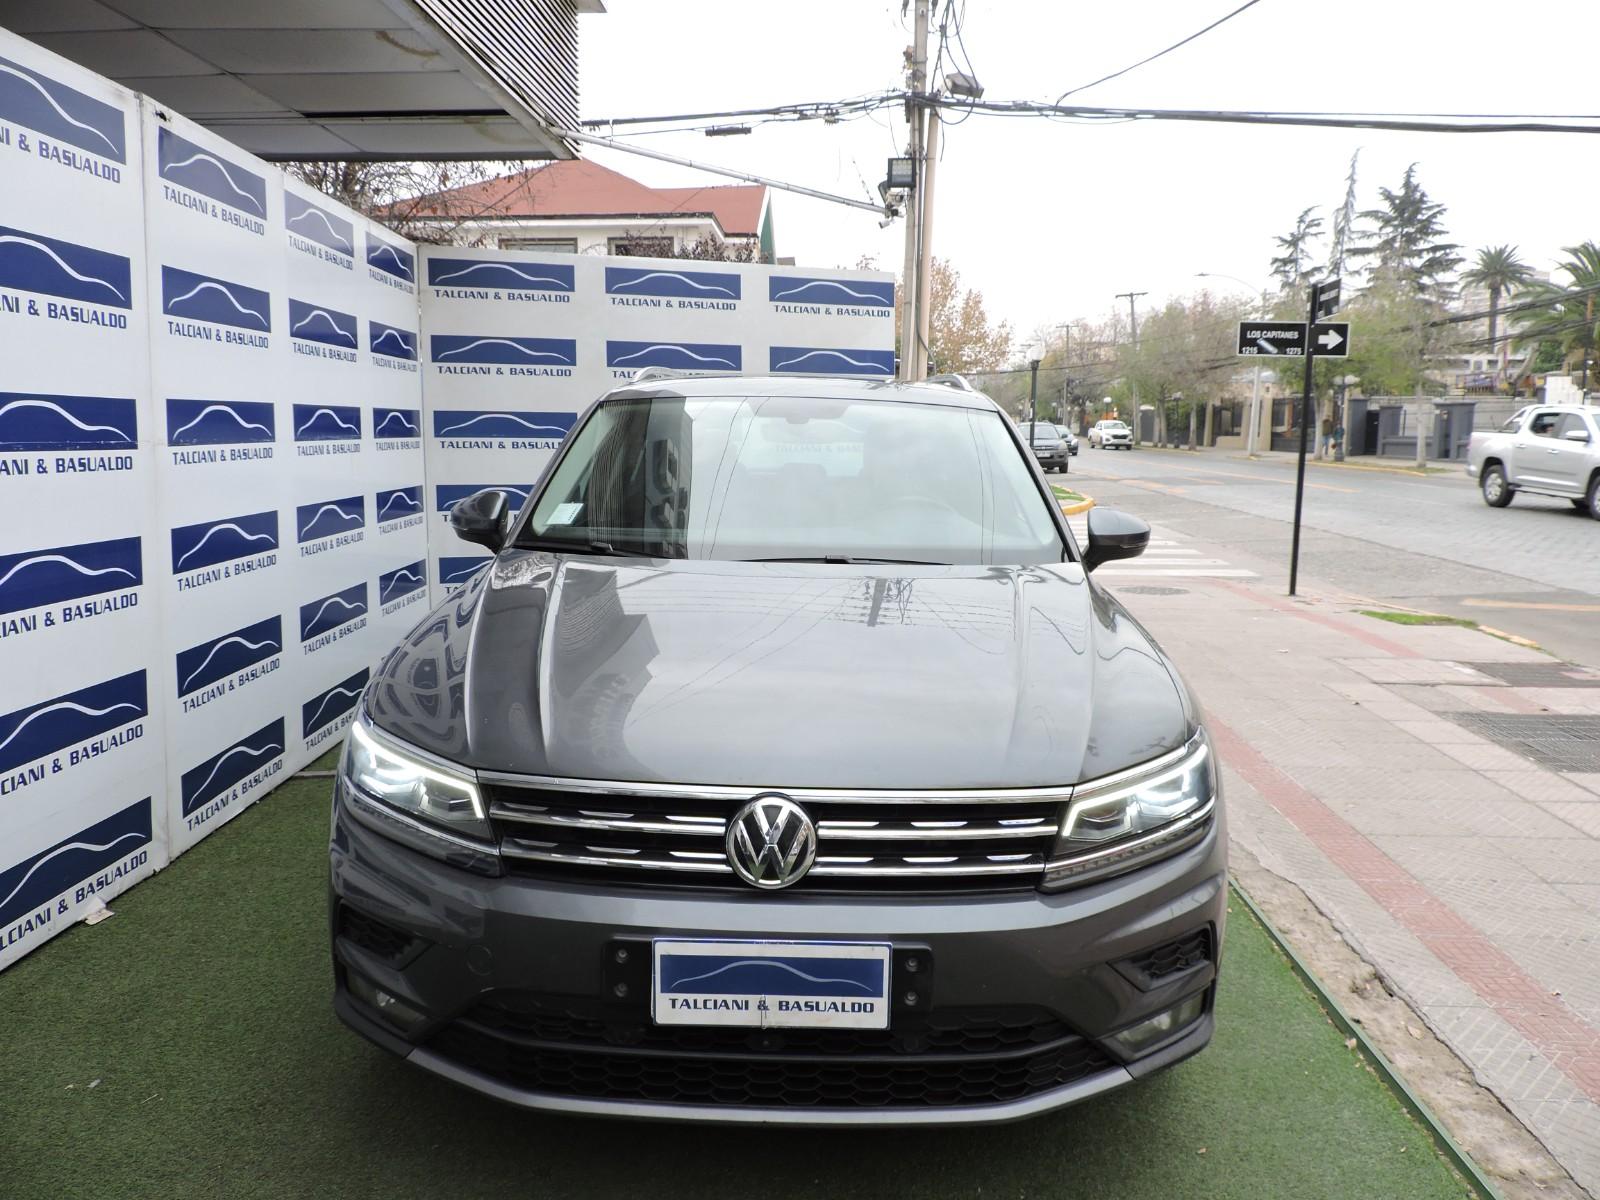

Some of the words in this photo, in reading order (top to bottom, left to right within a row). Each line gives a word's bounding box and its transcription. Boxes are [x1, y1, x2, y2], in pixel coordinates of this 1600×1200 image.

[19, 134, 31, 152] &
[39, 141, 120, 184] BASUALDO
[163, 185, 208, 218] TALCIANI
[211, 207, 218, 218] &
[221, 209, 264, 236] BASUALDO
[434, 289, 488, 299] TALCIANI
[494, 291, 501, 300] &
[508, 293, 570, 303] BASUALDO
[611, 297, 661, 307] TALCIANI
[665, 300, 673, 308] &
[679, 301, 736, 311] BASUALDO
[28, 300, 40, 316] &
[48, 303, 127, 329] BASUALDO
[774, 305, 821, 315] TALCIANI
[825, 307, 832, 316] &
[837, 308, 890, 317] BASUALDO
[168, 321, 212, 340] TALCIANI
[216, 330, 222, 342] &
[225, 331, 269, 349] BASUALDO
[1262, 331, 1299, 339] CAPITANES
[438, 366, 491, 375] TALCIANI
[496, 367, 504, 375] &
[510, 367, 572, 377] BASUALDO
[173, 450, 217, 465] TALCIANI
[220, 449, 226, 461] &
[230, 447, 273, 461] BASUALDO
[440, 440, 493, 449] TALCIANI
[498, 441, 505, 449] &
[512, 441, 561, 449] BASUAL
[37, 459, 48, 474] &
[56, 456, 133, 473] BASUALDO
[177, 568, 221, 592] TALCIANI
[224, 566, 231, 578] &
[234, 554, 277, 576] BASUALDO
[0, 614, 36, 638] IANI
[44, 612, 55, 627] &
[63, 592, 138, 623] BASUALDO
[183, 683, 225, 713] TALCIANI
[228, 680, 235, 692] &
[238, 658, 280, 687] BASUALDO
[1, 764, 44, 795] CIANI
[52, 758, 63, 774] &
[70, 724, 143, 767] BASUALDO
[187, 795, 229, 832] TALCIANI
[232, 789, 238, 801] &
[241, 759, 282, 796] BASUALDO
[0, 908, 51, 951] LCIANI
[58, 899, 68, 915] &
[75, 850, 148, 904] BASUALDO
[669, 998, 749, 1011] TALCIANI
[757, 998, 769, 1011] &
[778, 1000, 875, 1013] BASUALDO
